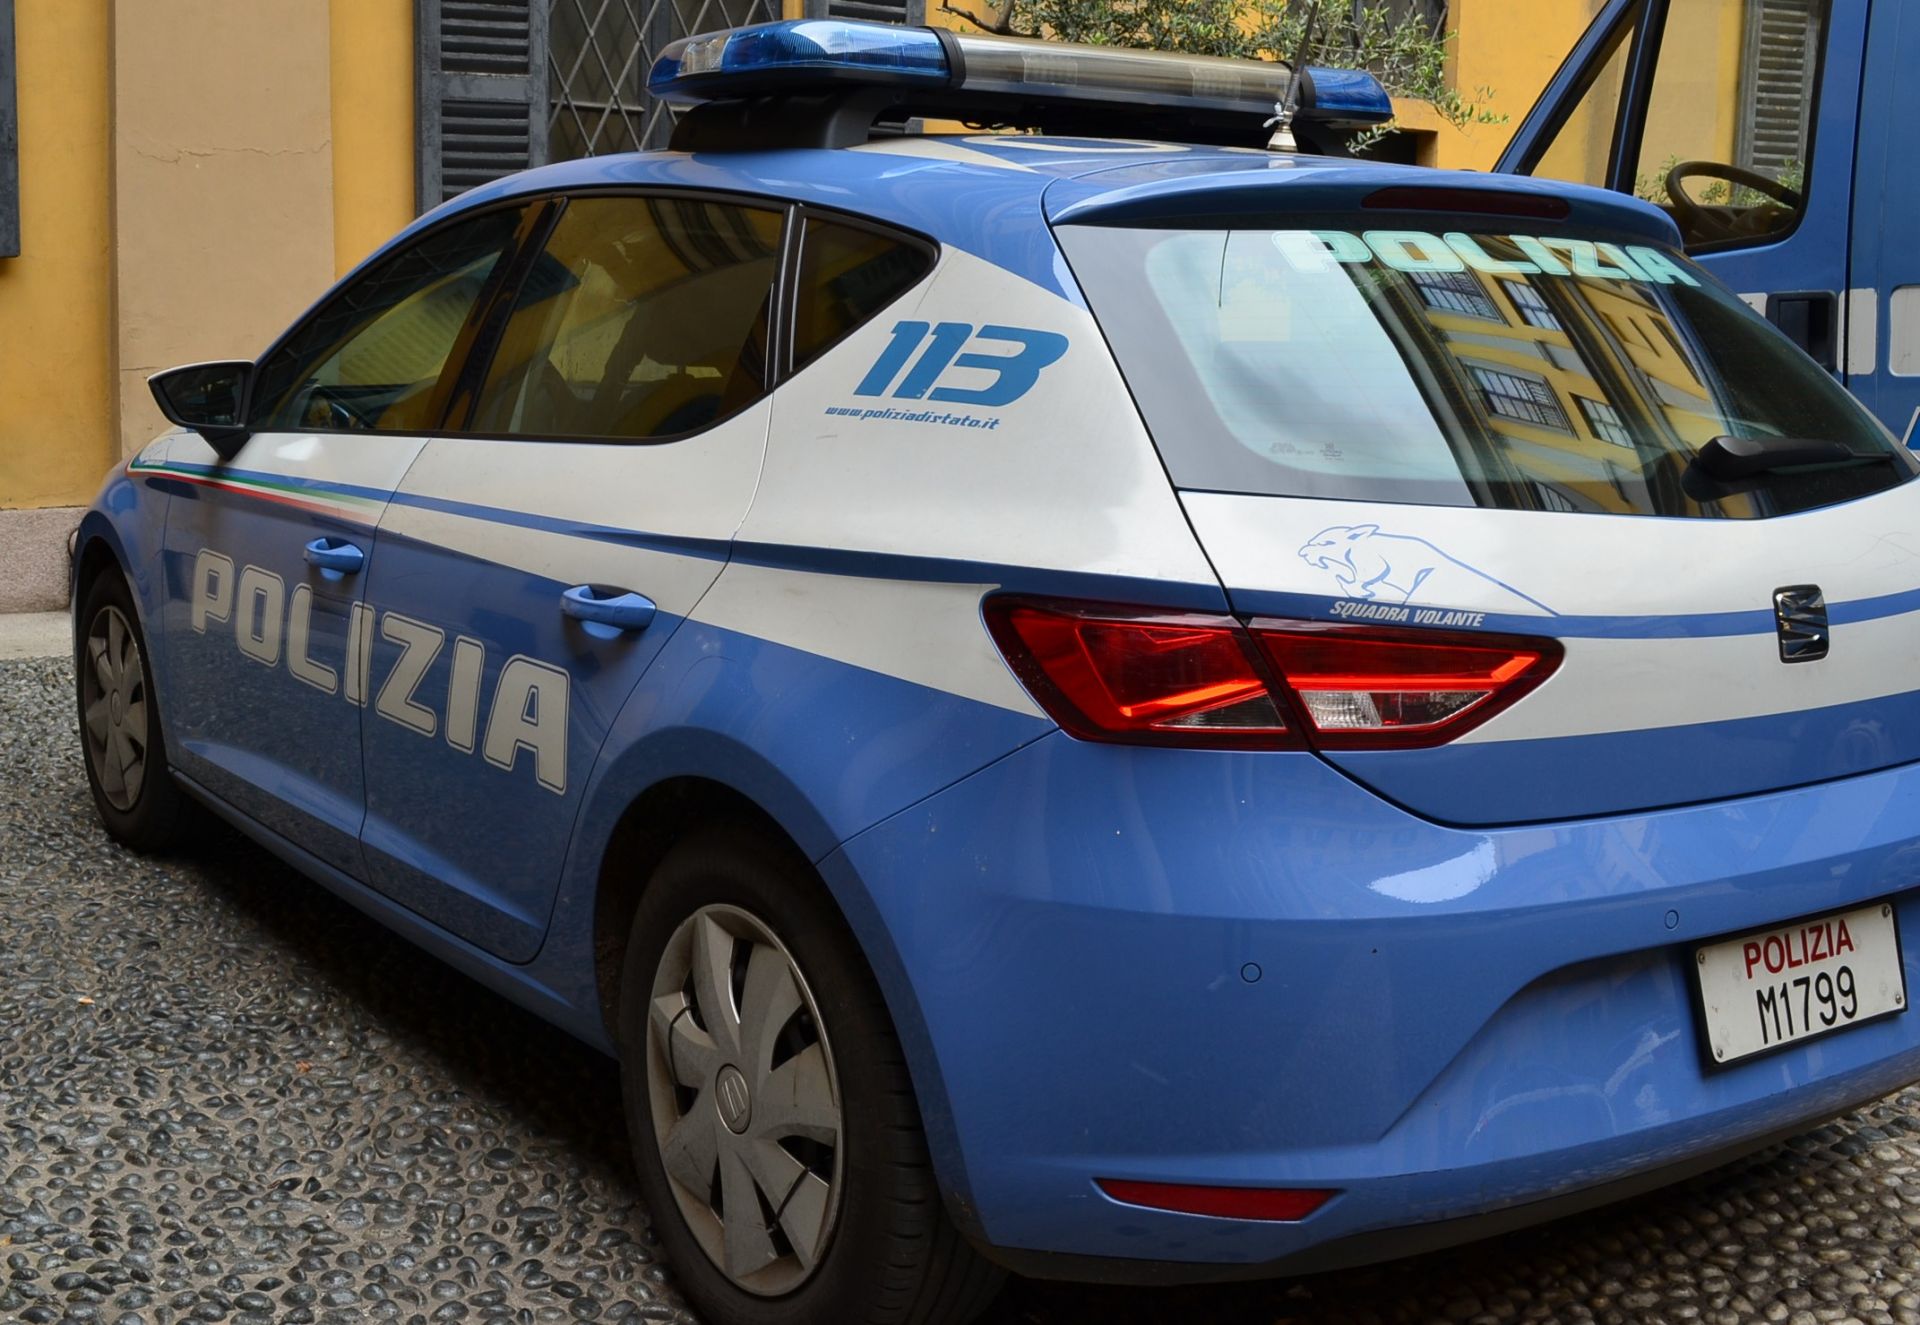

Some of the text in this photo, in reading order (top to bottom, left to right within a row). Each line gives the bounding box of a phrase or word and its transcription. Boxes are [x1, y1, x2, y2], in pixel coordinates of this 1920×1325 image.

[1272, 230, 1702, 286] POLIZIA
[853, 320, 1070, 407] 113
[825, 406, 1000, 430] www.poliziadistato.it
[1329, 600, 1486, 627] SQUADRA VOLANTE
[192, 548, 570, 796] POLIZIA
[1743, 919, 1855, 979] POLIZIA
[1756, 965, 1858, 1044] M1799
